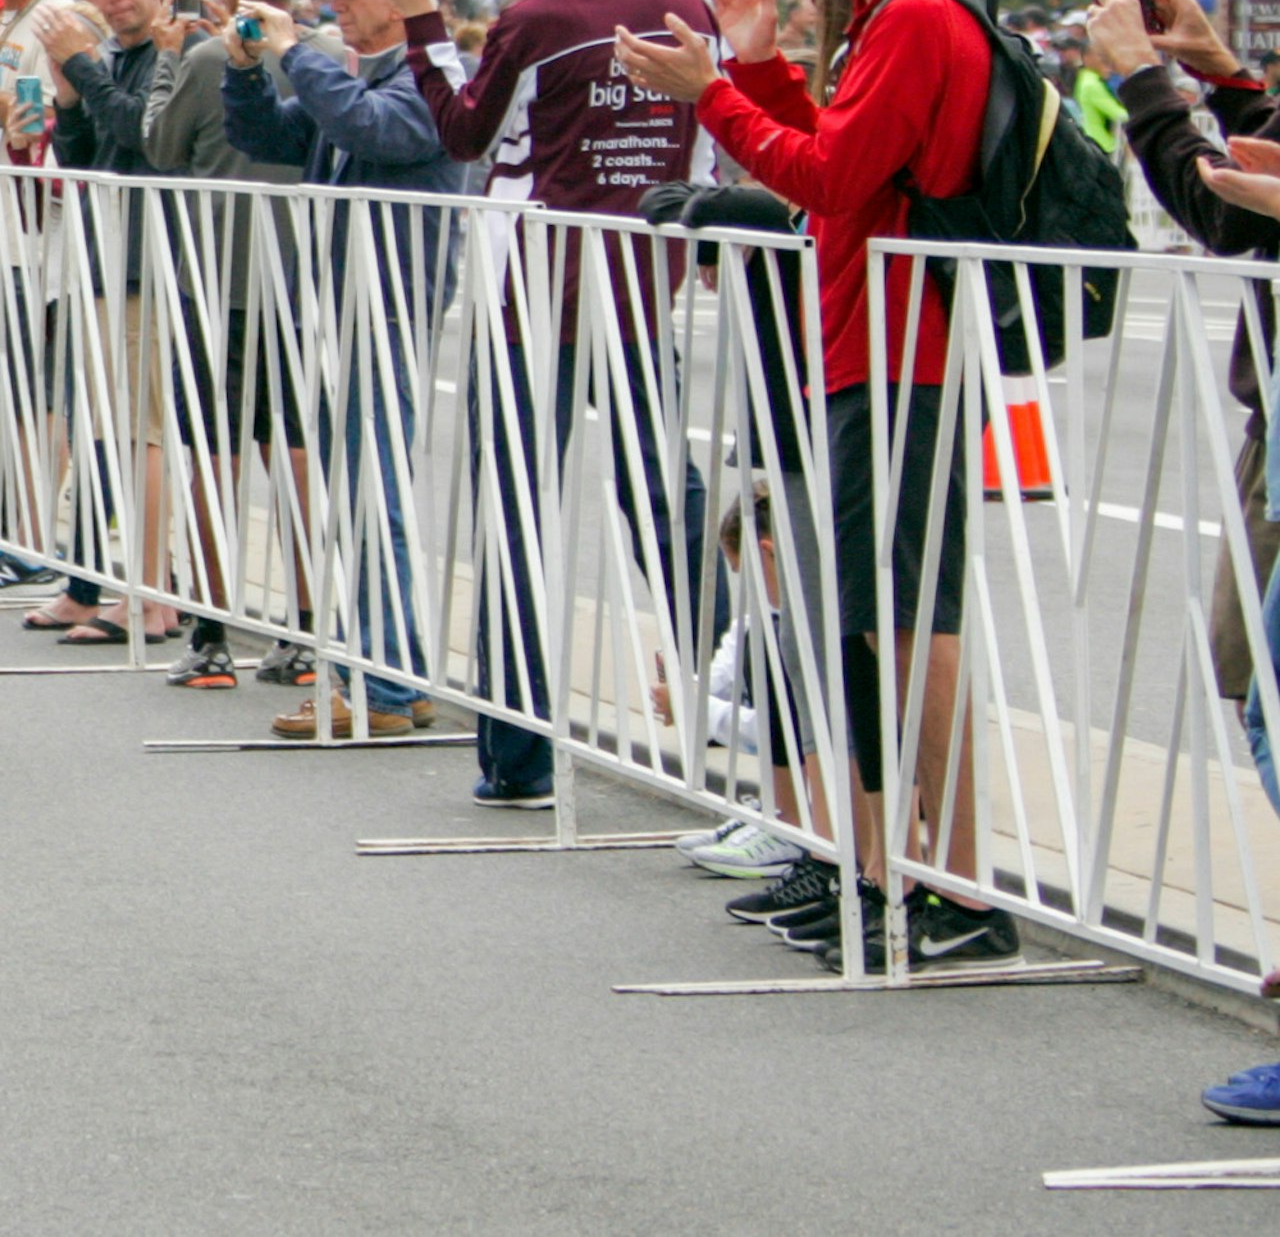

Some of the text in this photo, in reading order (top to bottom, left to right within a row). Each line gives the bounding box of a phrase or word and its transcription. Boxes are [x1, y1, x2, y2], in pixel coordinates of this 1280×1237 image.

[589, 80, 627, 111] big
[633, 85, 671, 102] su
[581, 139, 590, 151] 2
[592, 155, 603, 168] 2
[597, 172, 607, 185] 6
